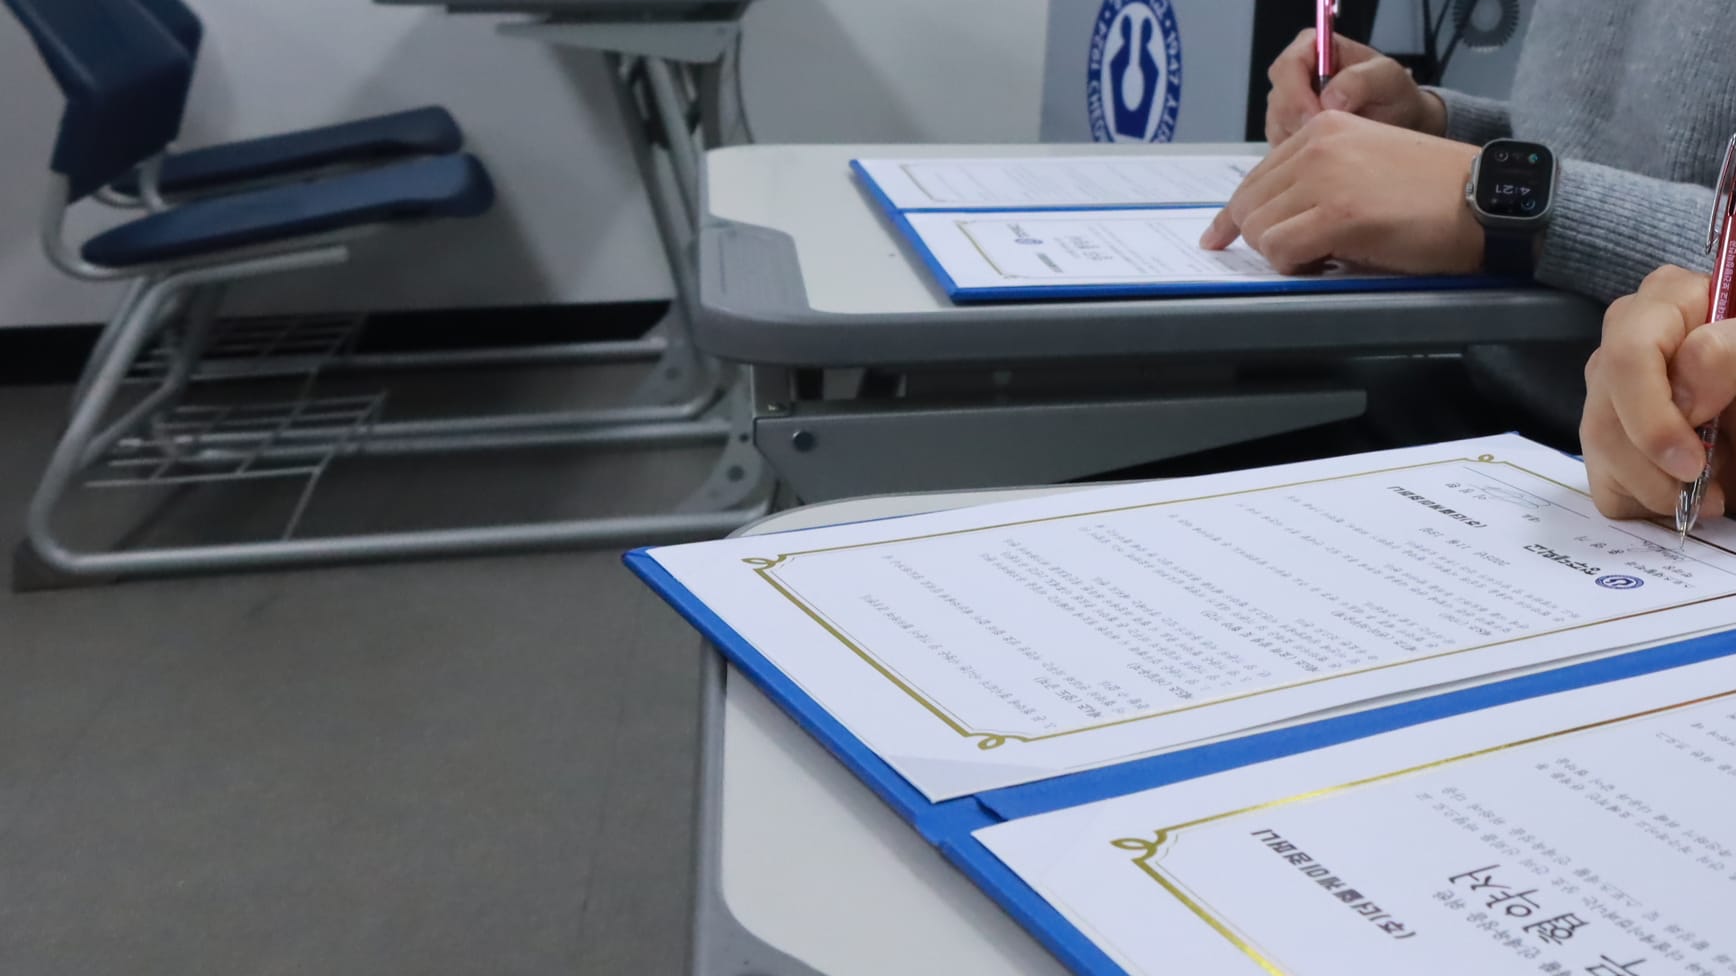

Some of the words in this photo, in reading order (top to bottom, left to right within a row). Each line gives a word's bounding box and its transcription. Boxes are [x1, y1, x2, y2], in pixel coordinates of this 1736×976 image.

[1716, 291, 1729, 320] 주대학교
[1523, 544, 1600, 575] 청주대학교
[1449, 864, 1589, 946] 협약서
